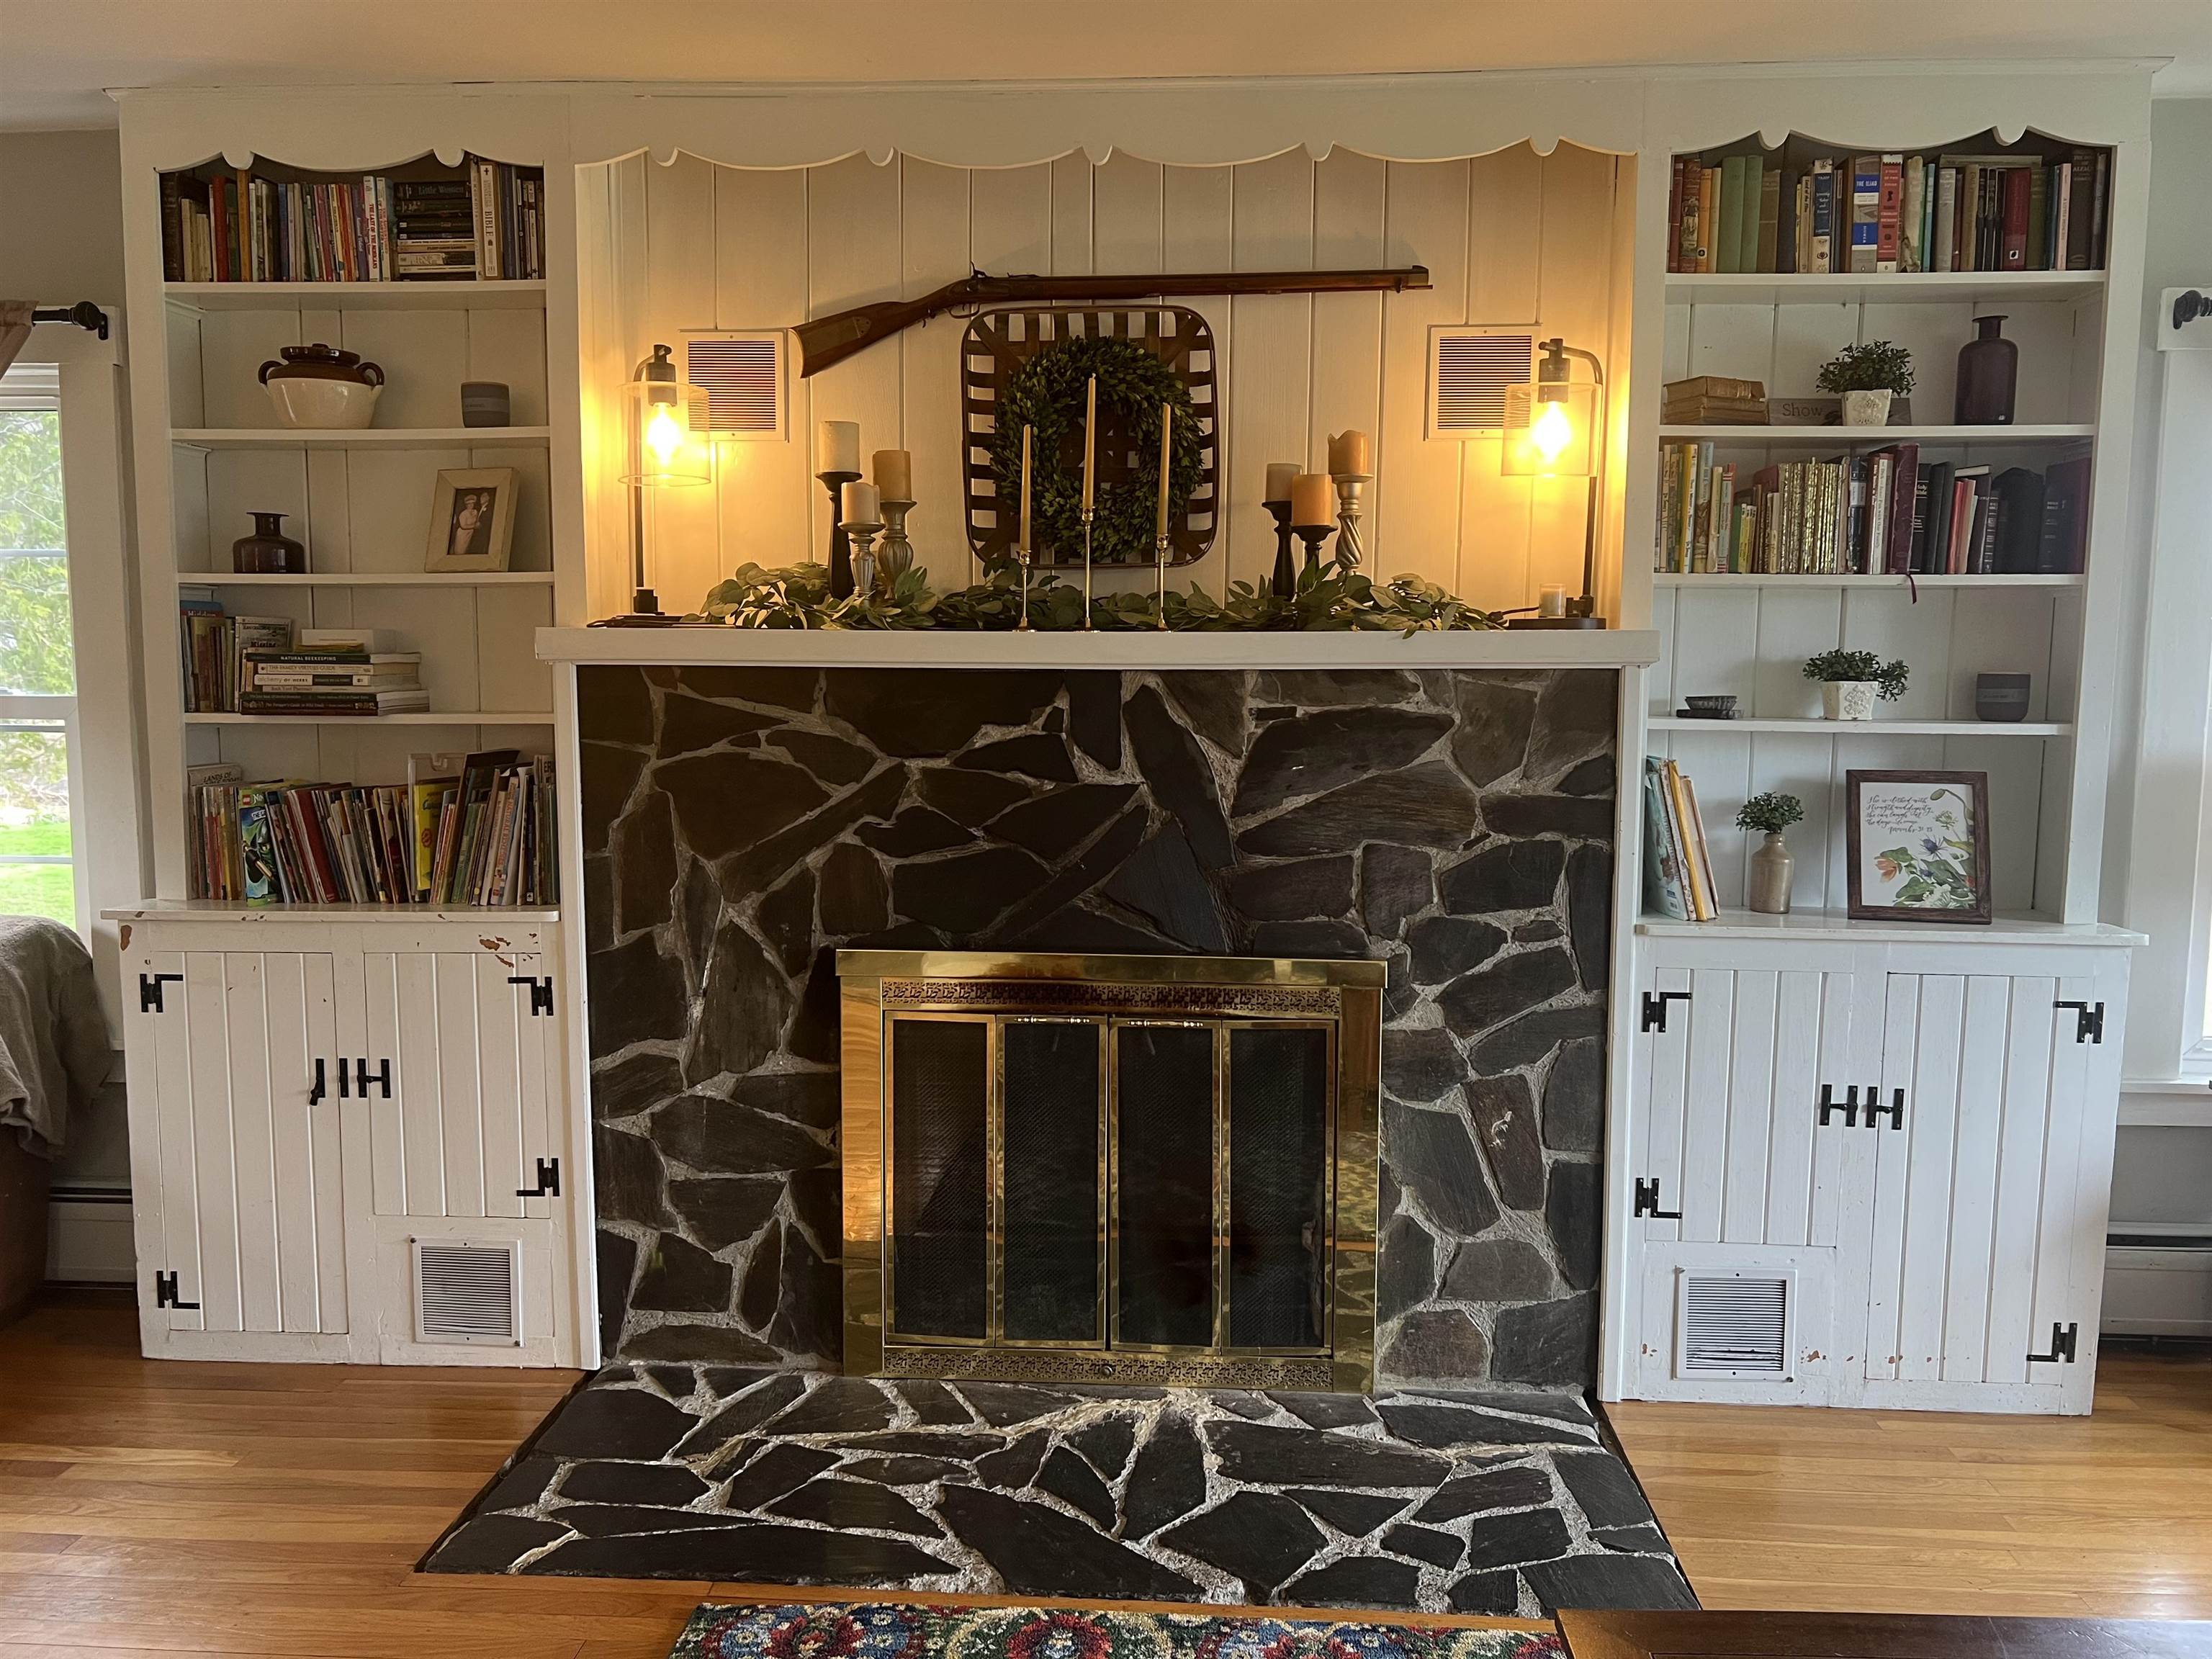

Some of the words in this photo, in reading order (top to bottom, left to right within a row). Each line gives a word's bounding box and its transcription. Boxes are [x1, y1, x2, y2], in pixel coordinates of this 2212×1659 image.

[484, 210, 494, 236] BIBLE
[1782, 403, 1821, 416] Show
[203, 773, 223, 783] LANDS
